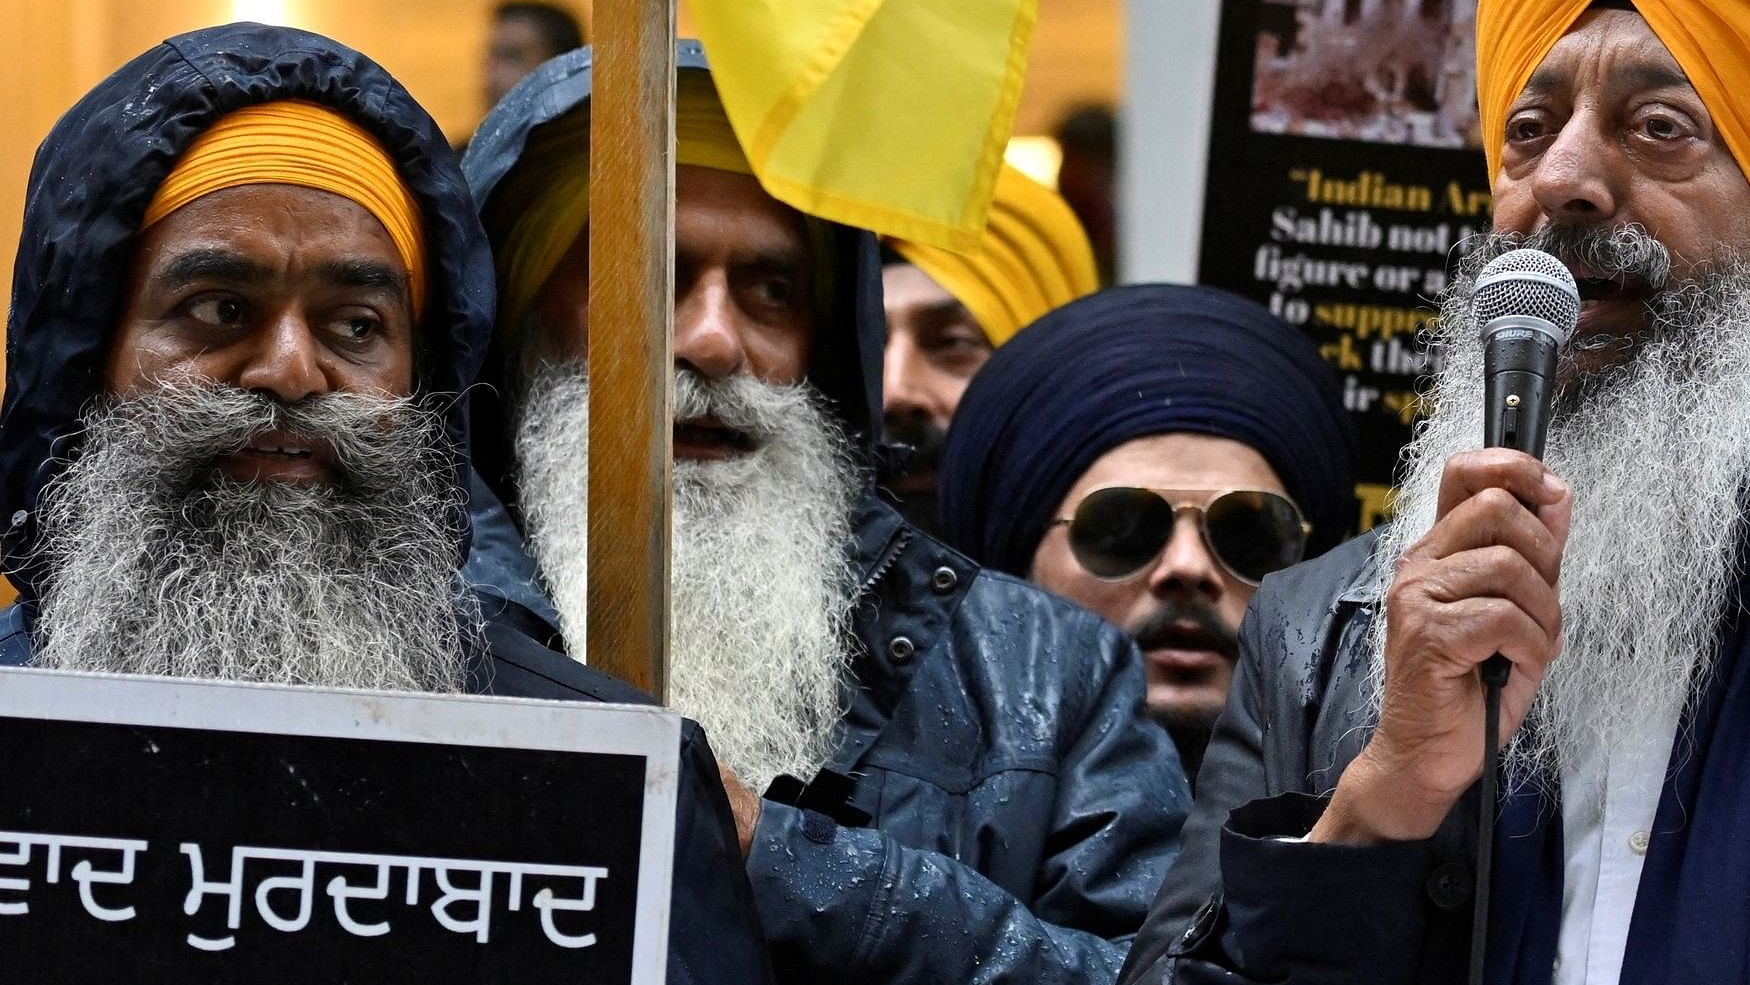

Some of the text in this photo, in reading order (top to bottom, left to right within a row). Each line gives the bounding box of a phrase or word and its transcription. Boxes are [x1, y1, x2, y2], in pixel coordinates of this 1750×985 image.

[1446, 180, 1493, 216] Ar
[1269, 206, 1382, 249] Sahib
[1387, 221, 1449, 255] not
[1254, 244, 1369, 294] figure
[1373, 266, 1420, 294] or
[1268, 292, 1311, 324] to
[180, 842, 608, 952] ਮੁਰਦਾਬਾਦ
